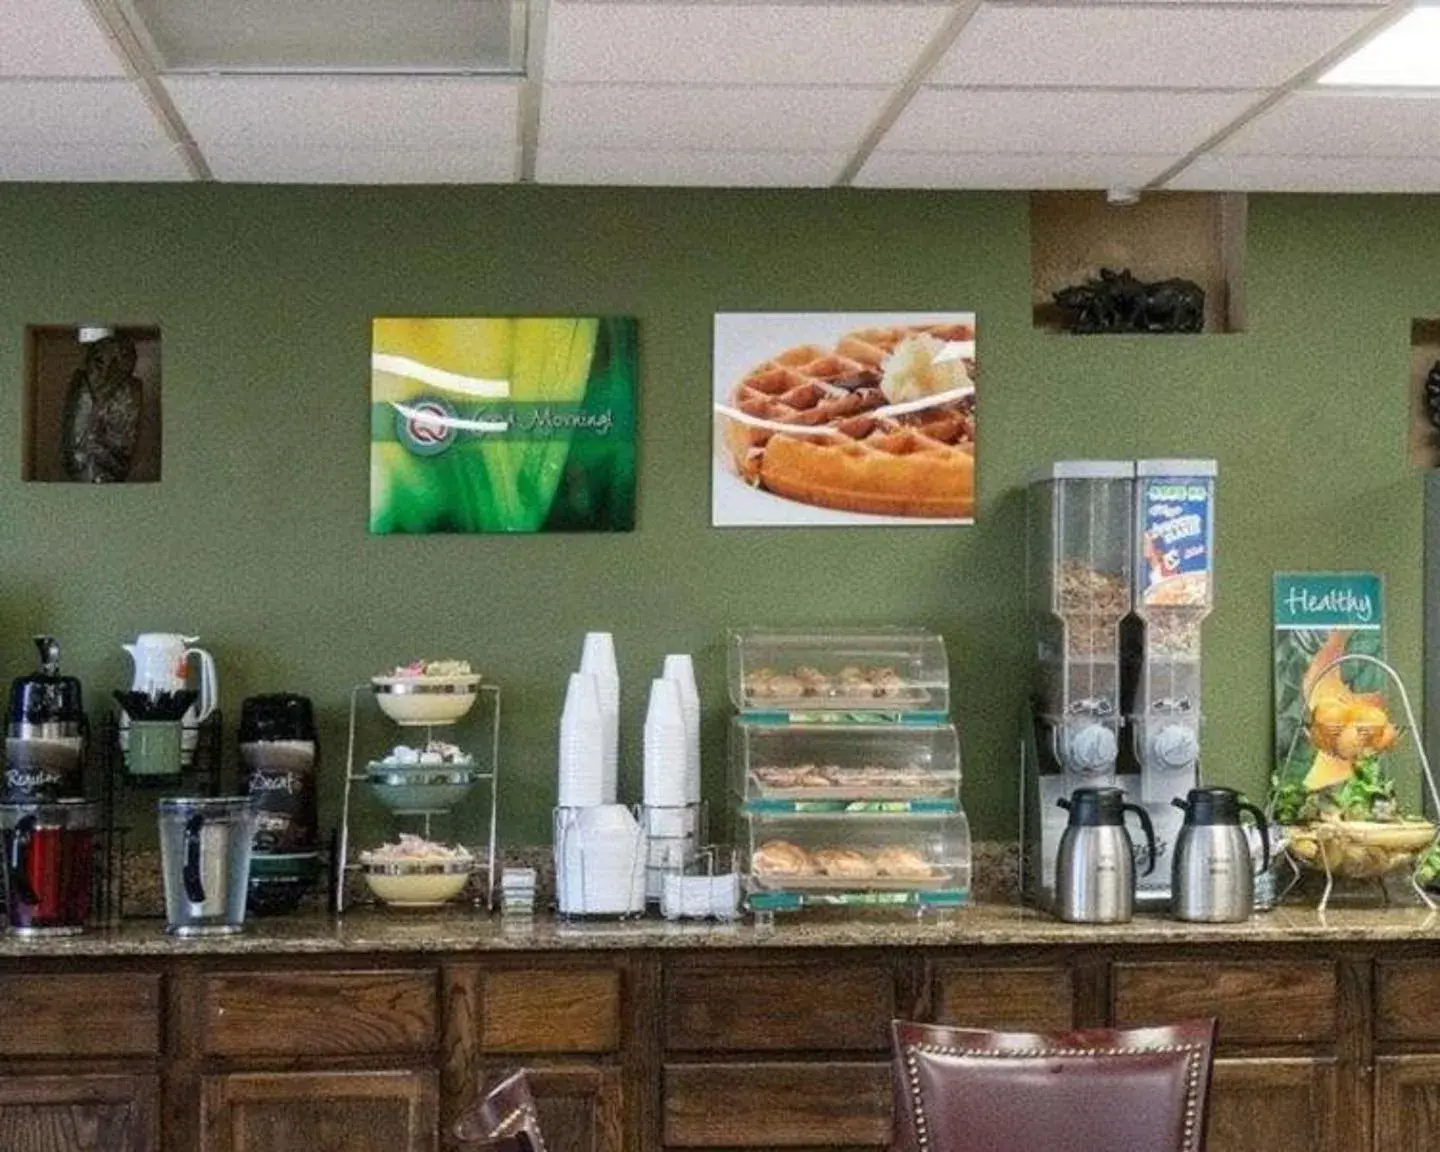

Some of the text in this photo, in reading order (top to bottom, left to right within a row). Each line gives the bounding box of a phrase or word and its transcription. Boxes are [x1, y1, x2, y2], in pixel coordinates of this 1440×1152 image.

[1283, 586, 1373, 622] Healthy
[6, 768, 62, 795] Regular
[249, 768, 296, 795] Decaf
